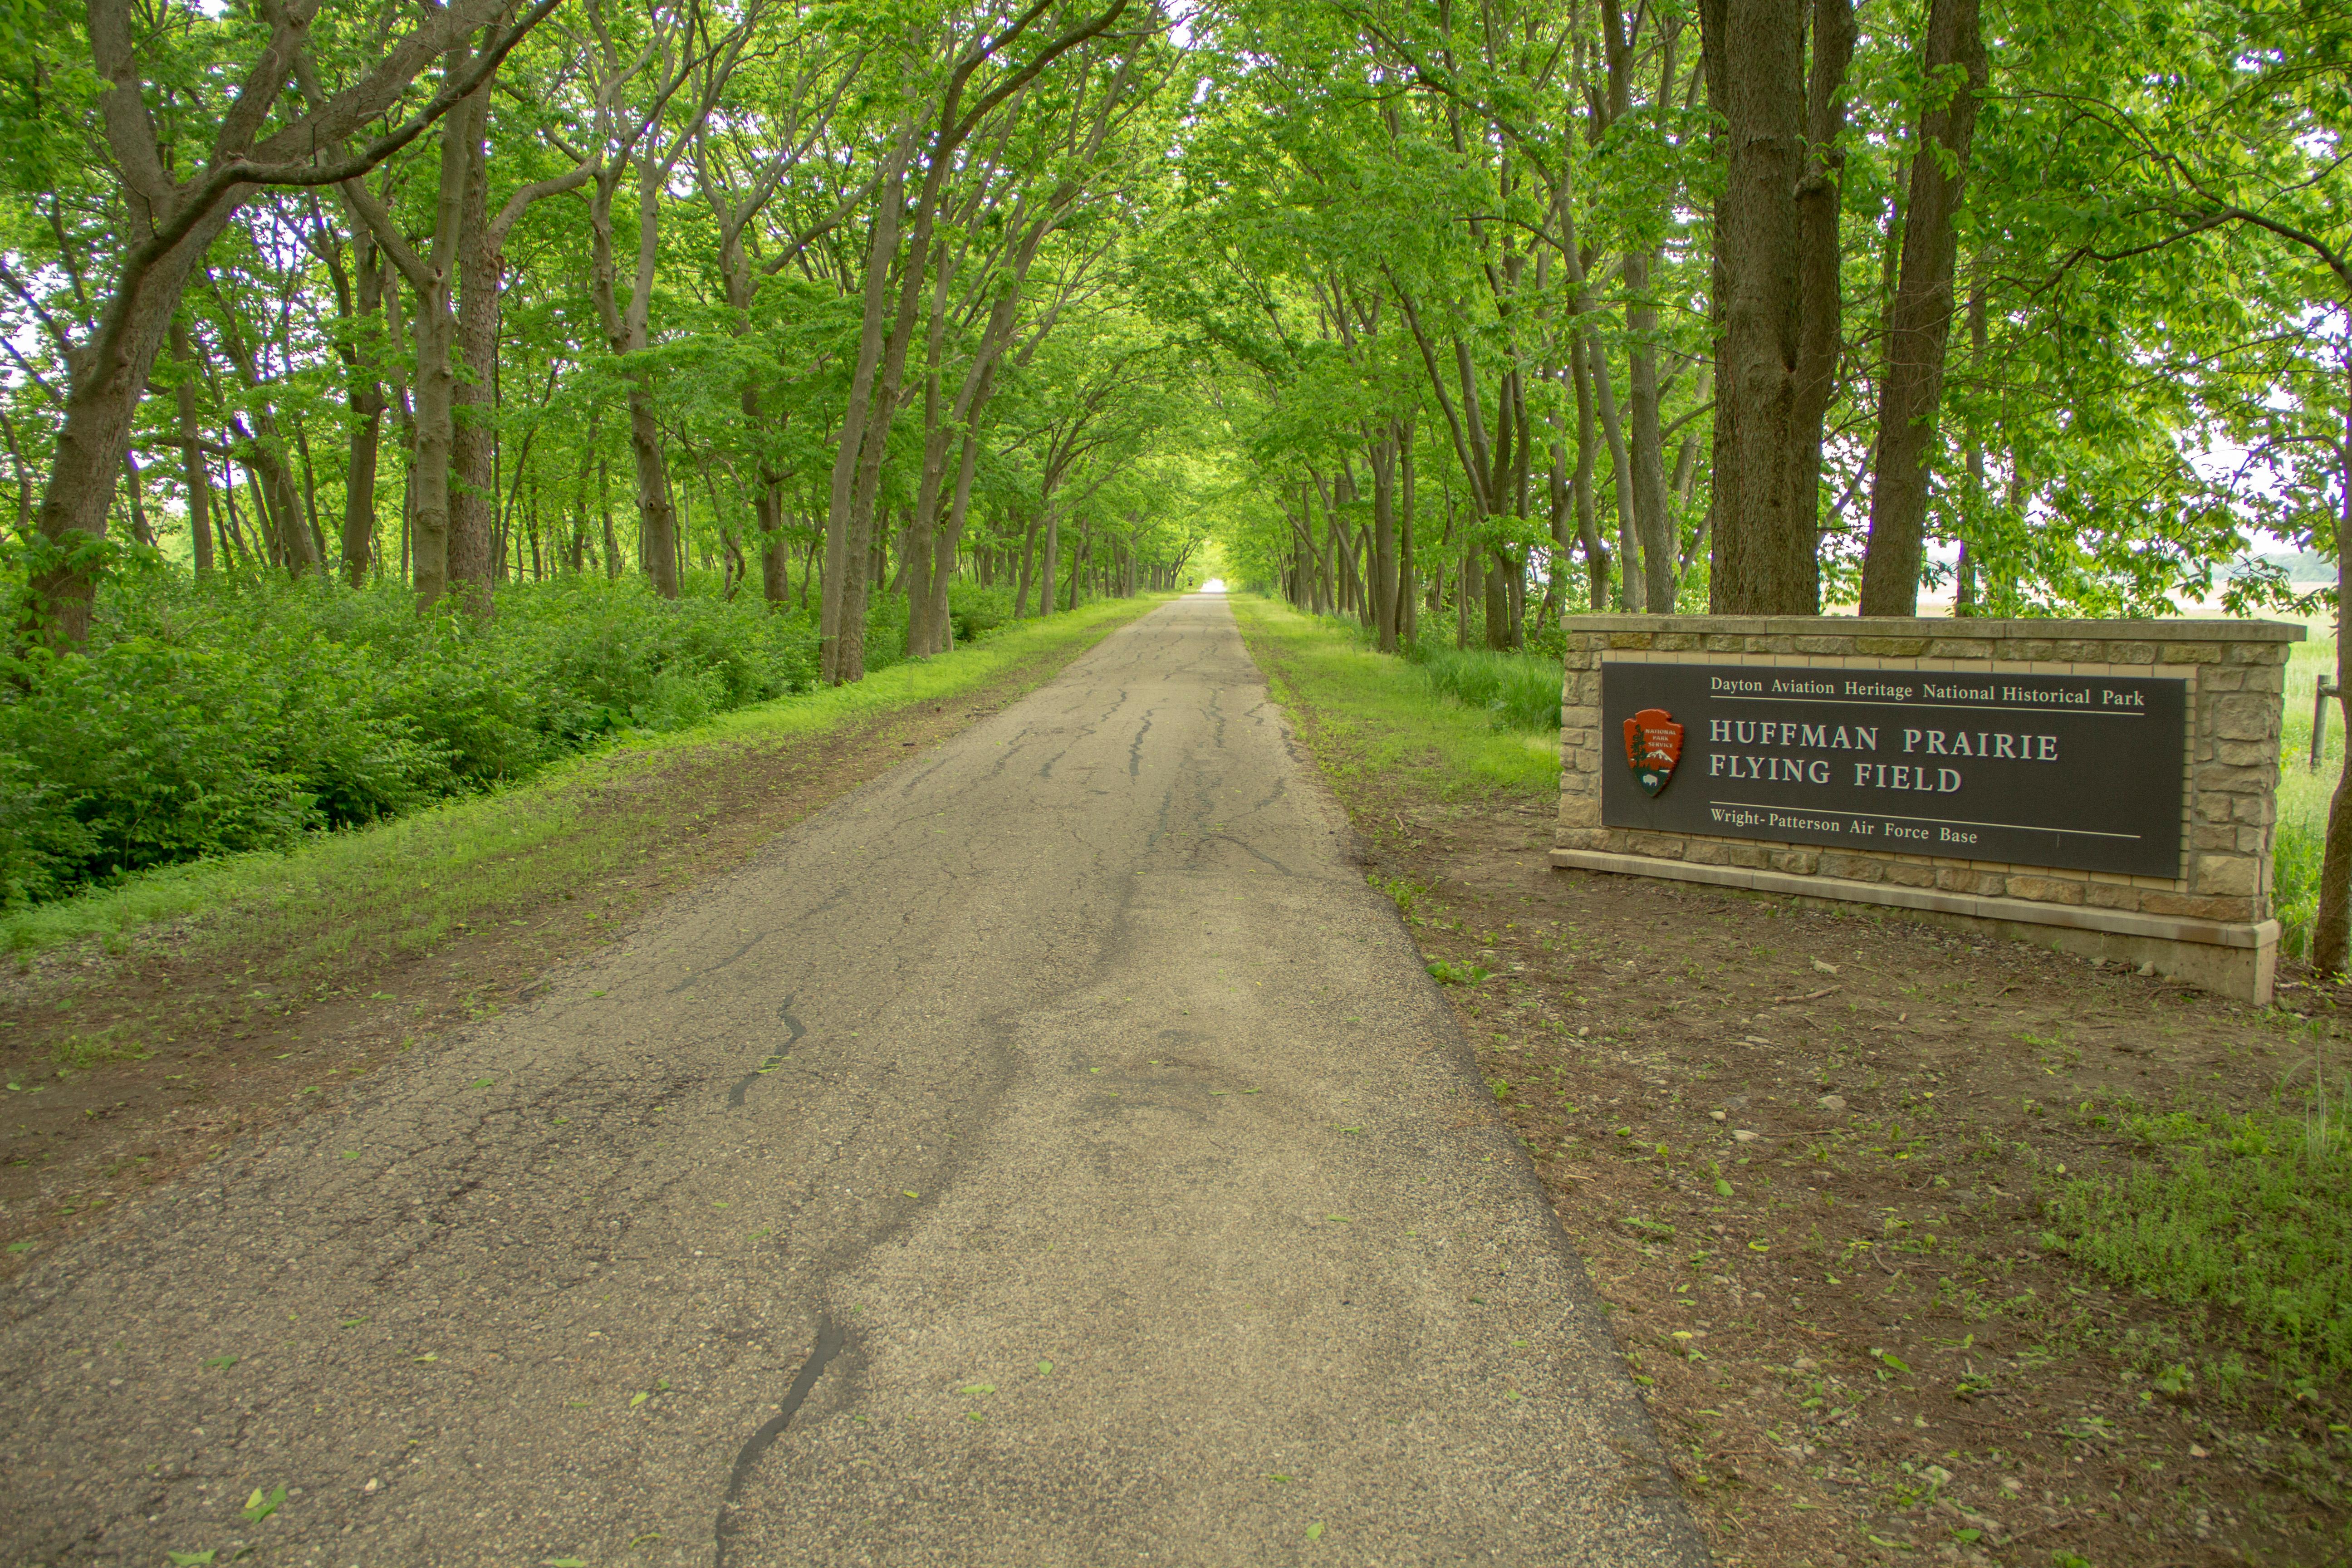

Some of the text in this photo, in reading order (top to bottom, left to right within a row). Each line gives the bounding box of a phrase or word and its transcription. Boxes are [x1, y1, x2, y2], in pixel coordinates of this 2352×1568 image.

[1710, 676, 2144, 706] Dayton Aviation Heritage National Historical Park
[1710, 719, 2058, 761] HUFFMAN PRAIRIE
[1710, 754, 1961, 793] FLYING FIELD
[1851, 820, 1874, 834] Air
[1884, 823, 1928, 839] Force
[1940, 827, 1977, 843] Base
